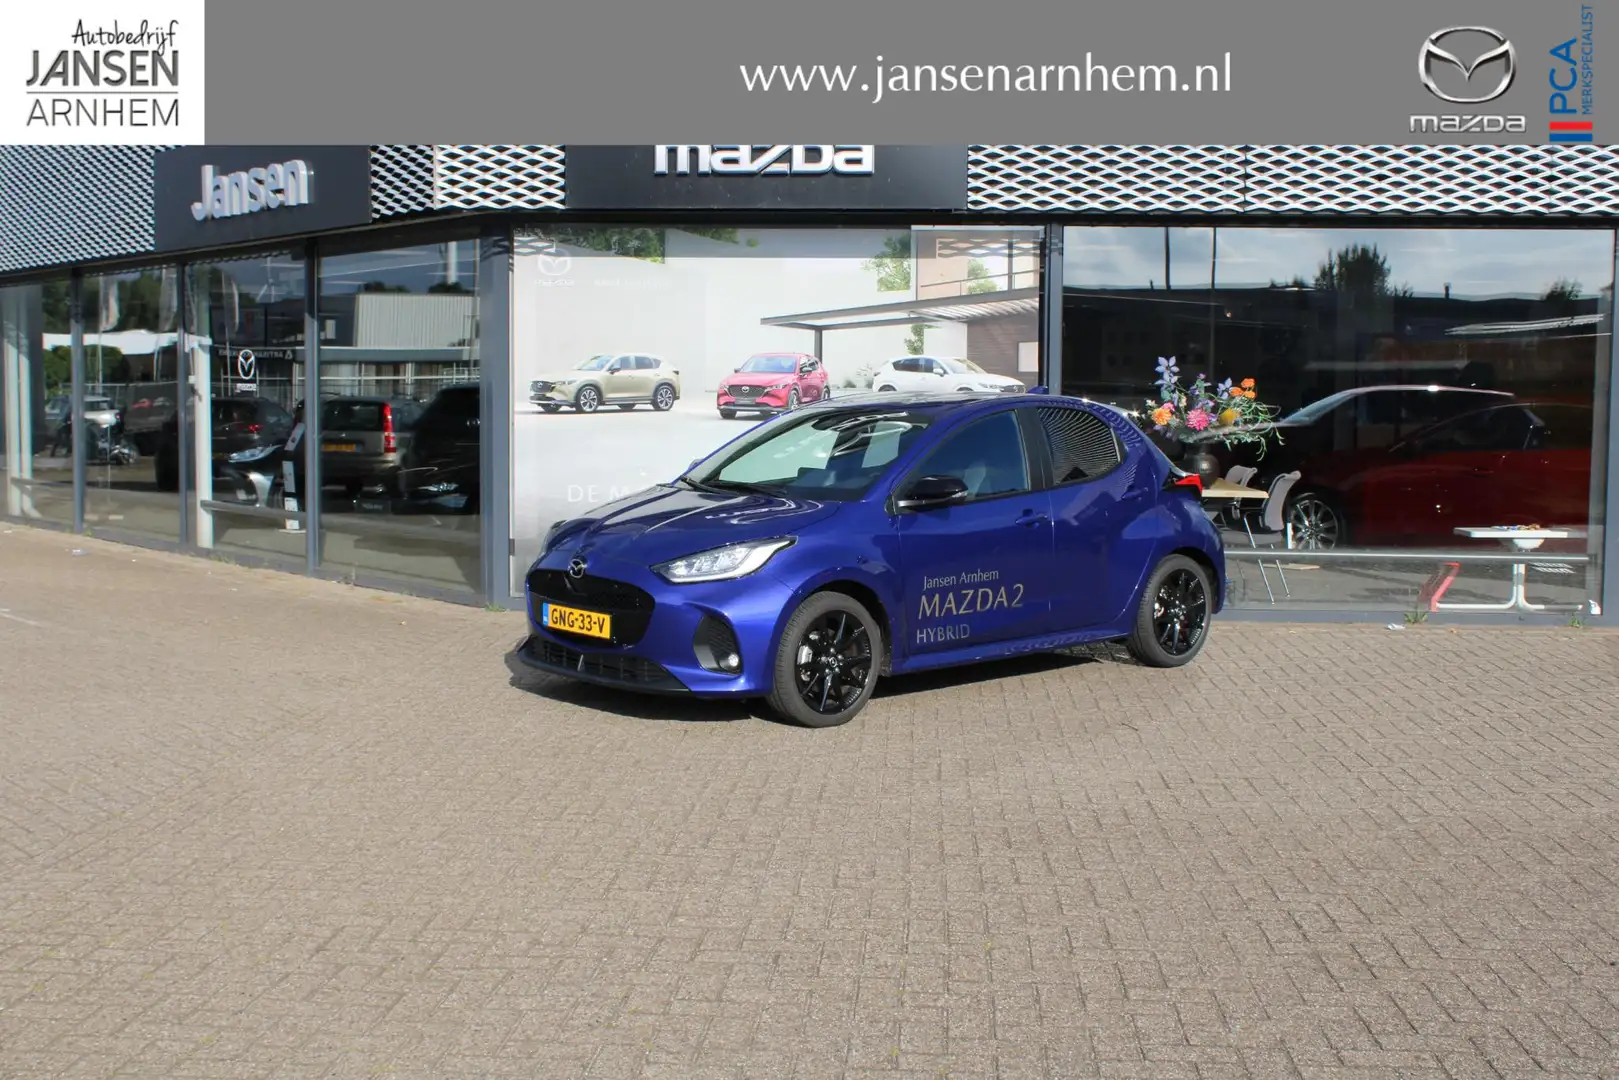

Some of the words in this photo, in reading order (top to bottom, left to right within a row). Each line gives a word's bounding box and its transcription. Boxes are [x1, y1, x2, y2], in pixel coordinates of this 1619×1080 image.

[190, 159, 309, 221] Jansen
[566, 484, 599, 503] DE
[923, 575, 957, 592] Jansen
[959, 568, 999, 584] Arnhem
[551, 608, 605, 634] GNG-33-V
[916, 623, 971, 644] HYBRID
